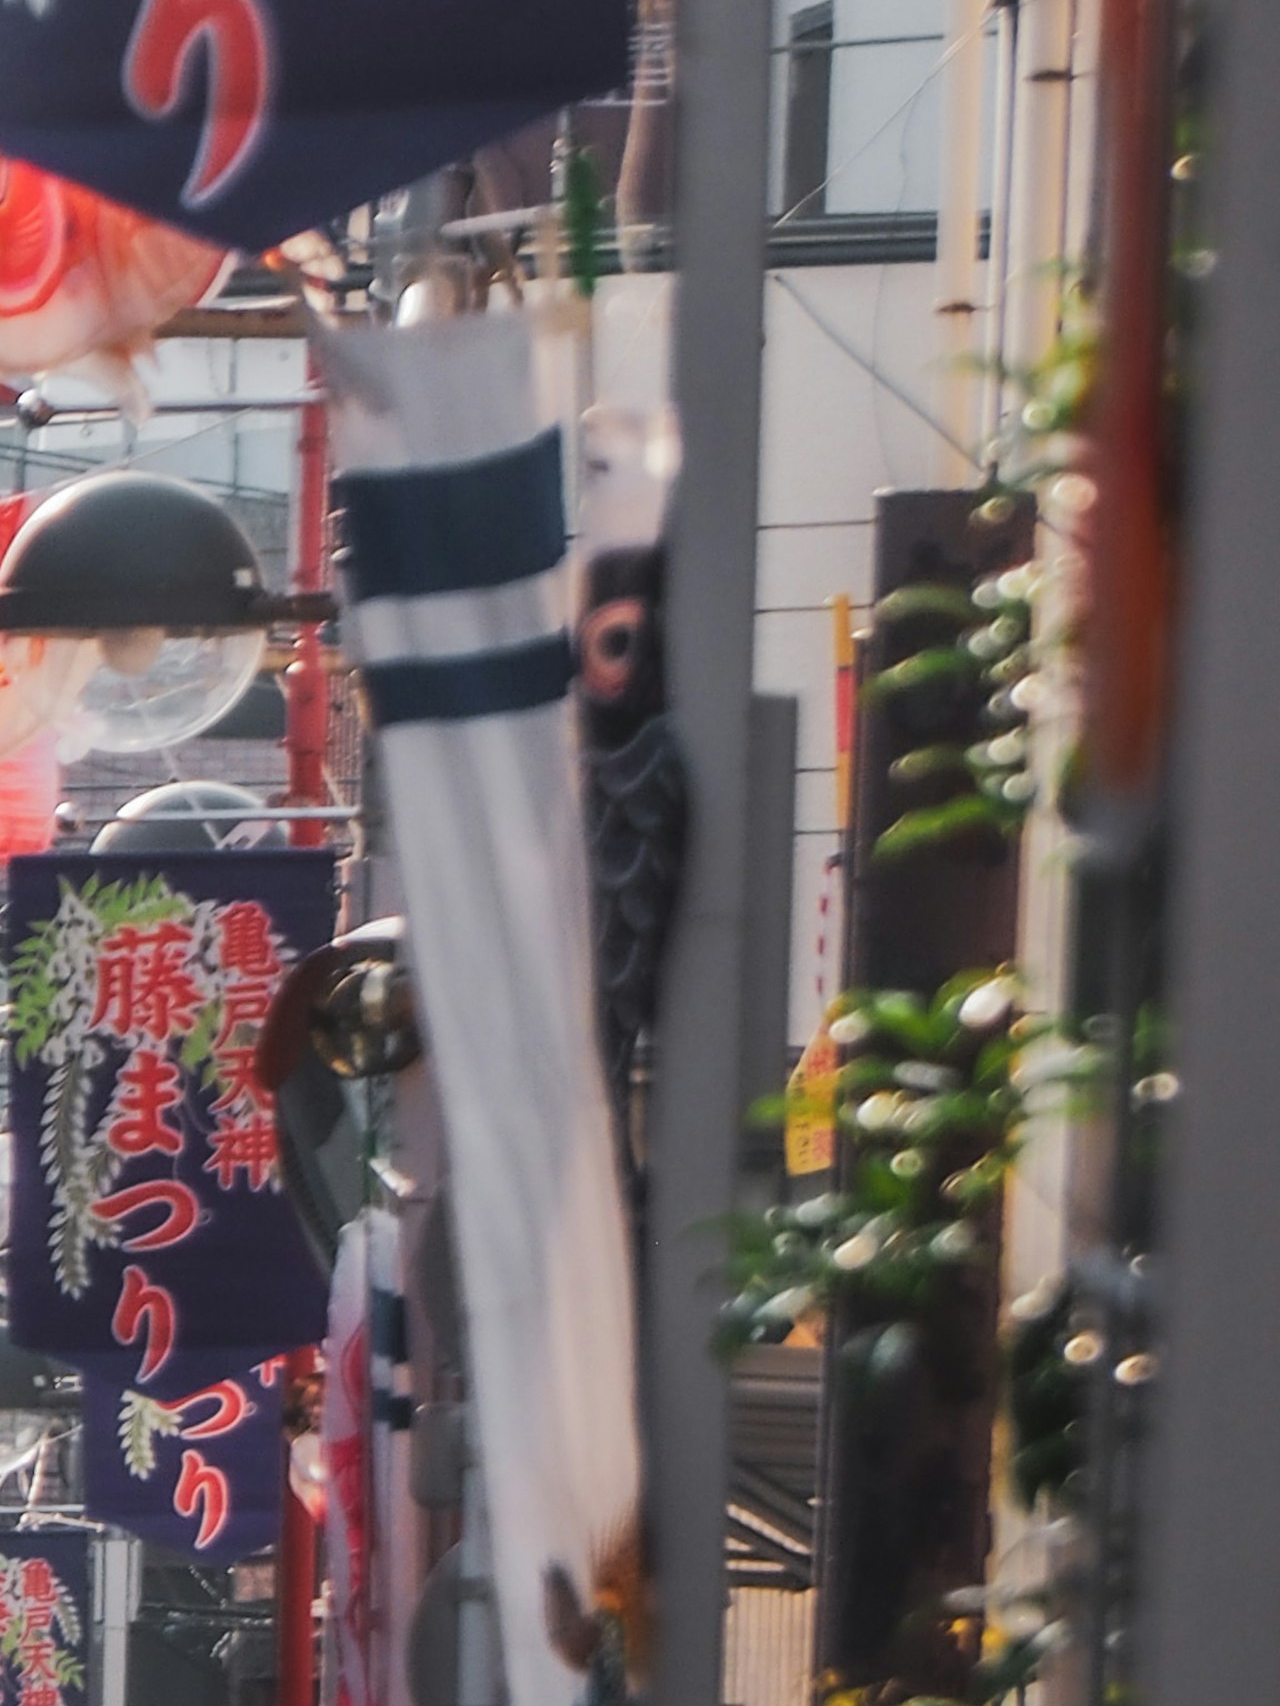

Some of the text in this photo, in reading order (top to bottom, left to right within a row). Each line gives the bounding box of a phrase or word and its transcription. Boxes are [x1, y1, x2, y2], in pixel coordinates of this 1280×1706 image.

[88, 920, 206, 1384] 藤まつり
[202, 899, 280, 1191] 亀戸天神
